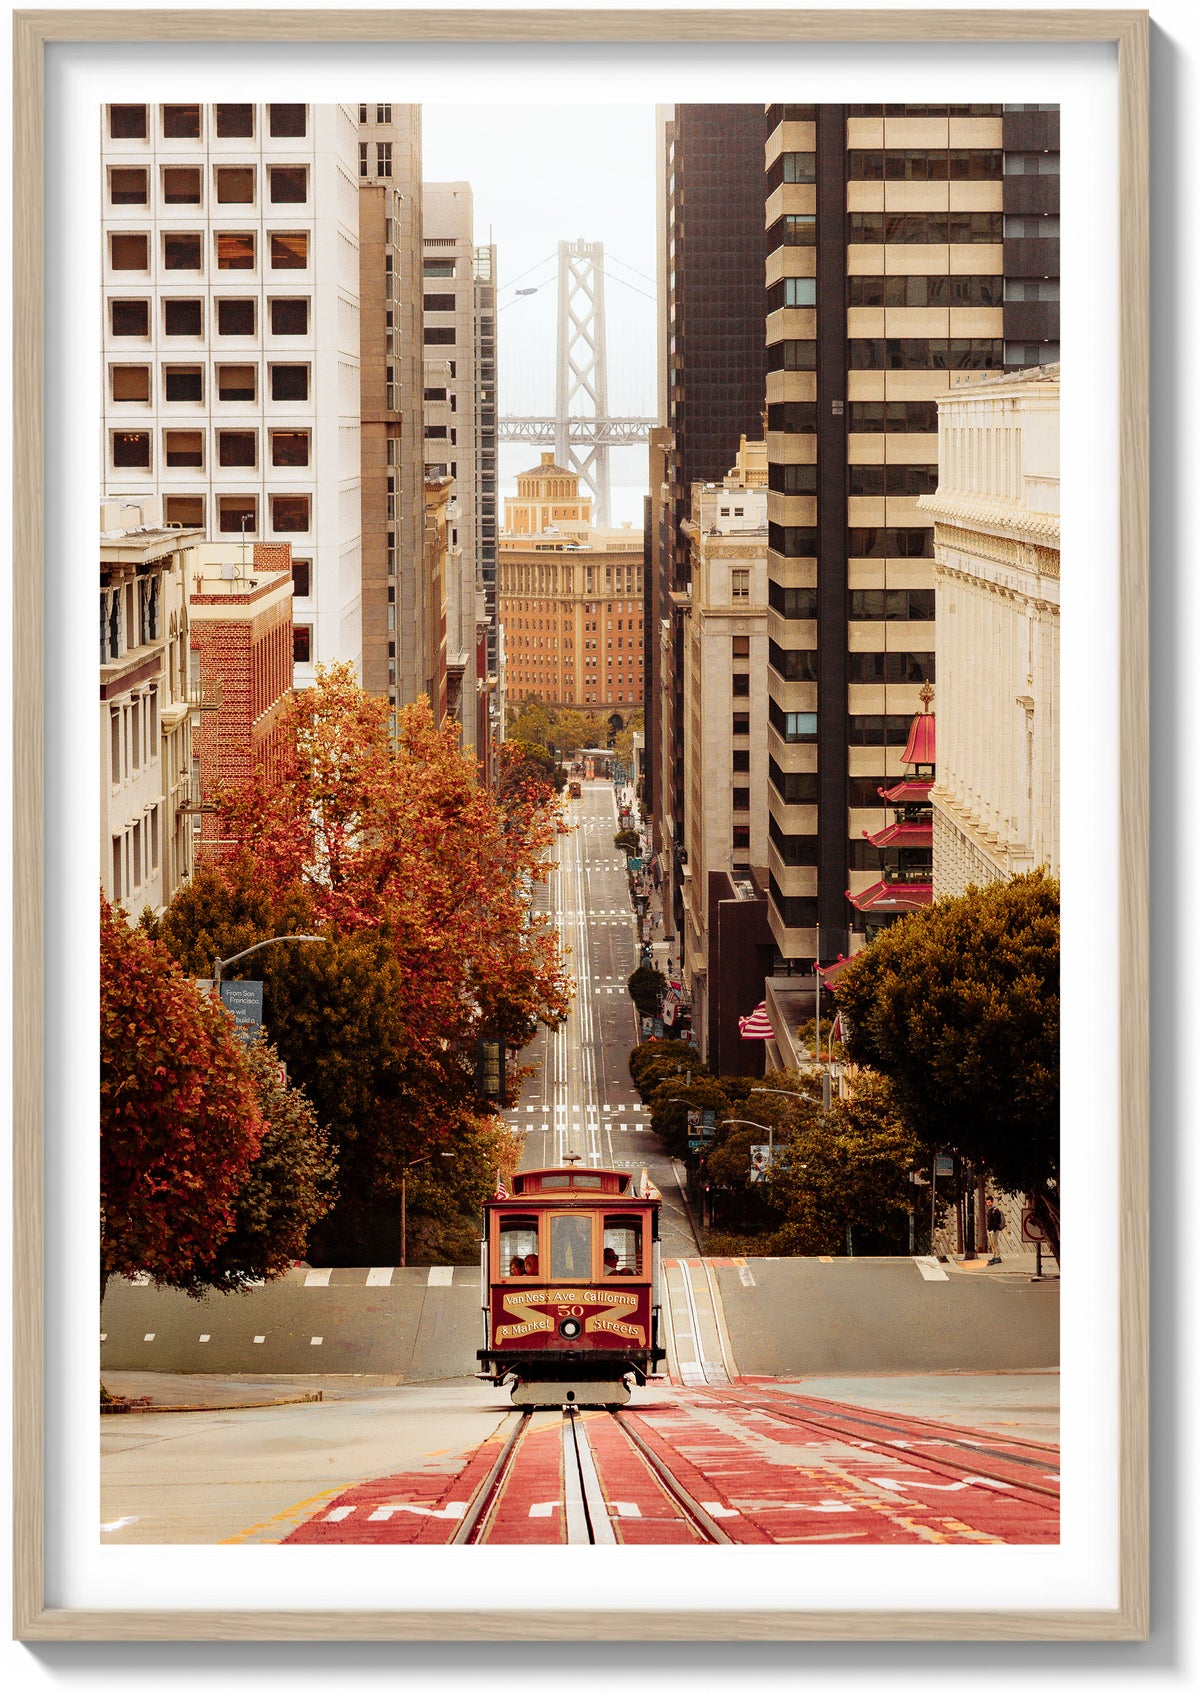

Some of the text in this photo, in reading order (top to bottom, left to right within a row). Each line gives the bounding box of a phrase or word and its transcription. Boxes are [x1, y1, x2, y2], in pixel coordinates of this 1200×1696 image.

[226, 989, 255, 997] From San
[506, 1296, 524, 1305] Van
[525, 1293, 551, 1303] Ness
[583, 1291, 636, 1305] California
[557, 1305, 584, 1317] 50
[501, 1319, 550, 1336] & Market
[594, 1319, 639, 1335] Streets
